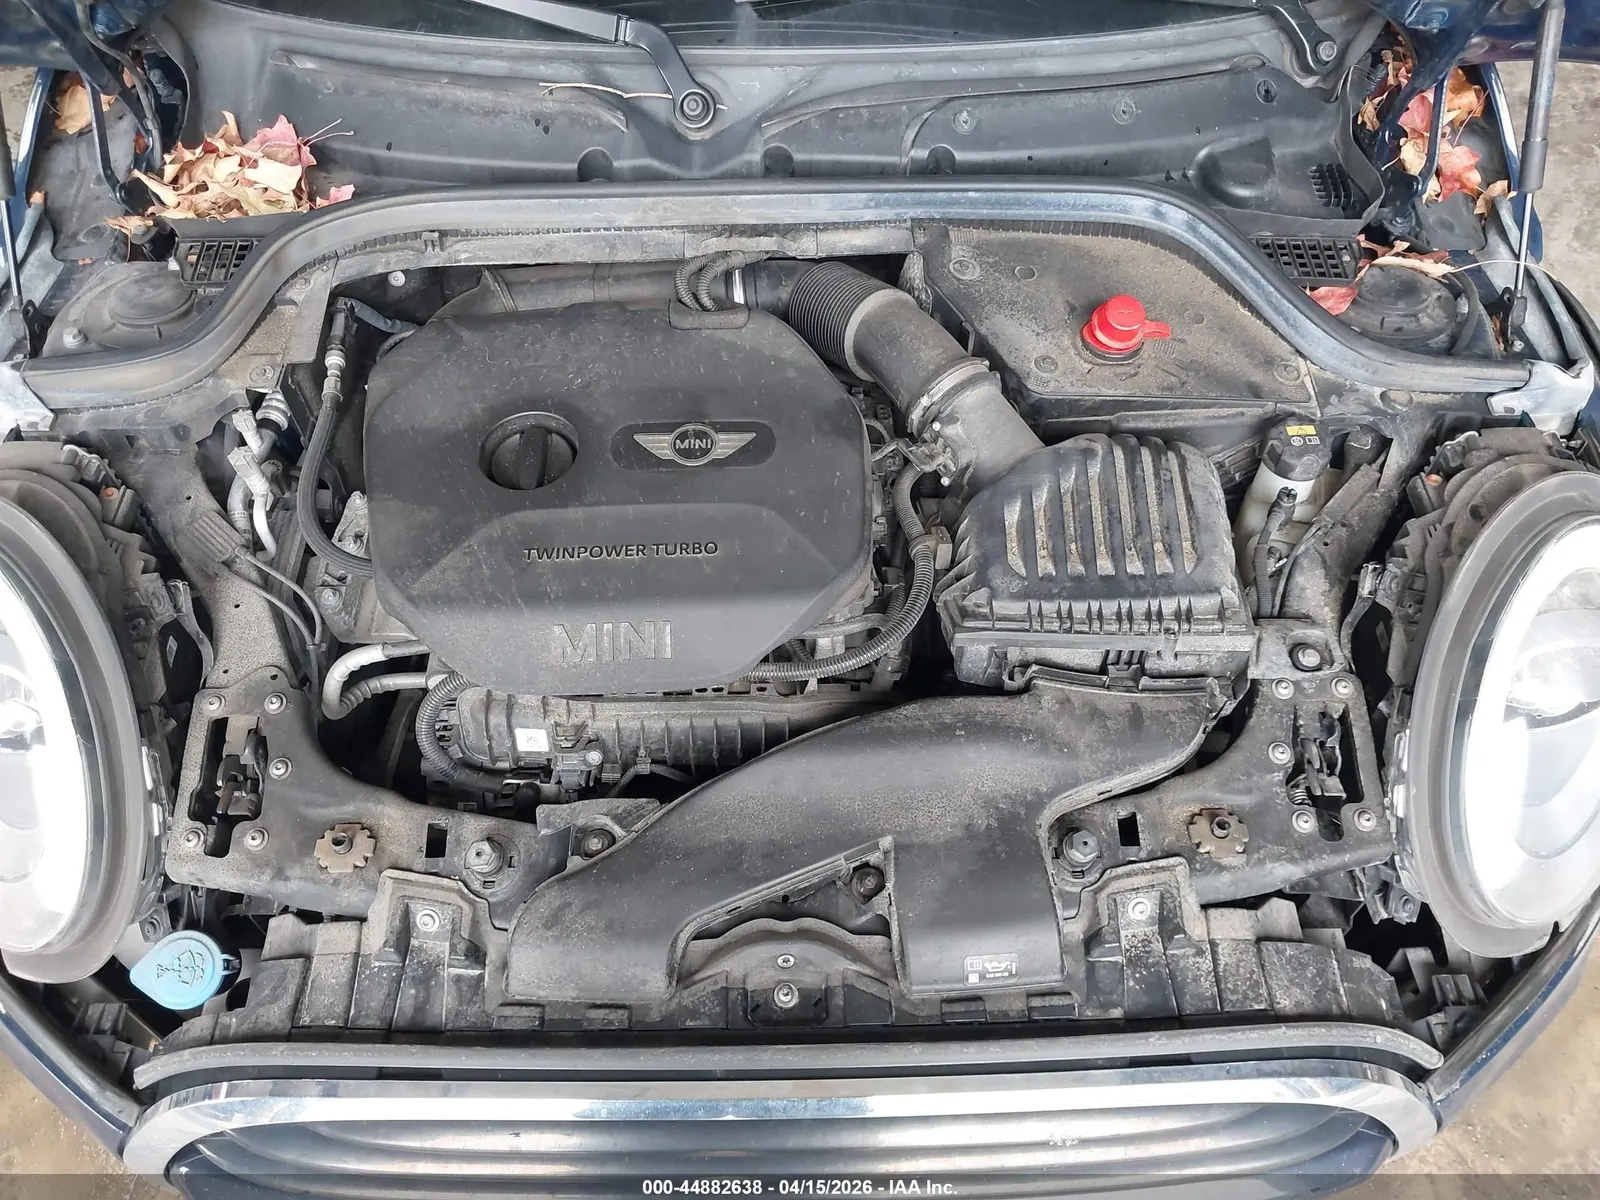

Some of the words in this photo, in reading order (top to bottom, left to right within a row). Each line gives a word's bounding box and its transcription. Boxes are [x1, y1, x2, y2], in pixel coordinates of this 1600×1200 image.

[675, 438, 712, 449] MINI
[524, 543, 647, 561] TWINPOWER
[651, 541, 718, 557] TURBO
[553, 620, 672, 662] MINI
